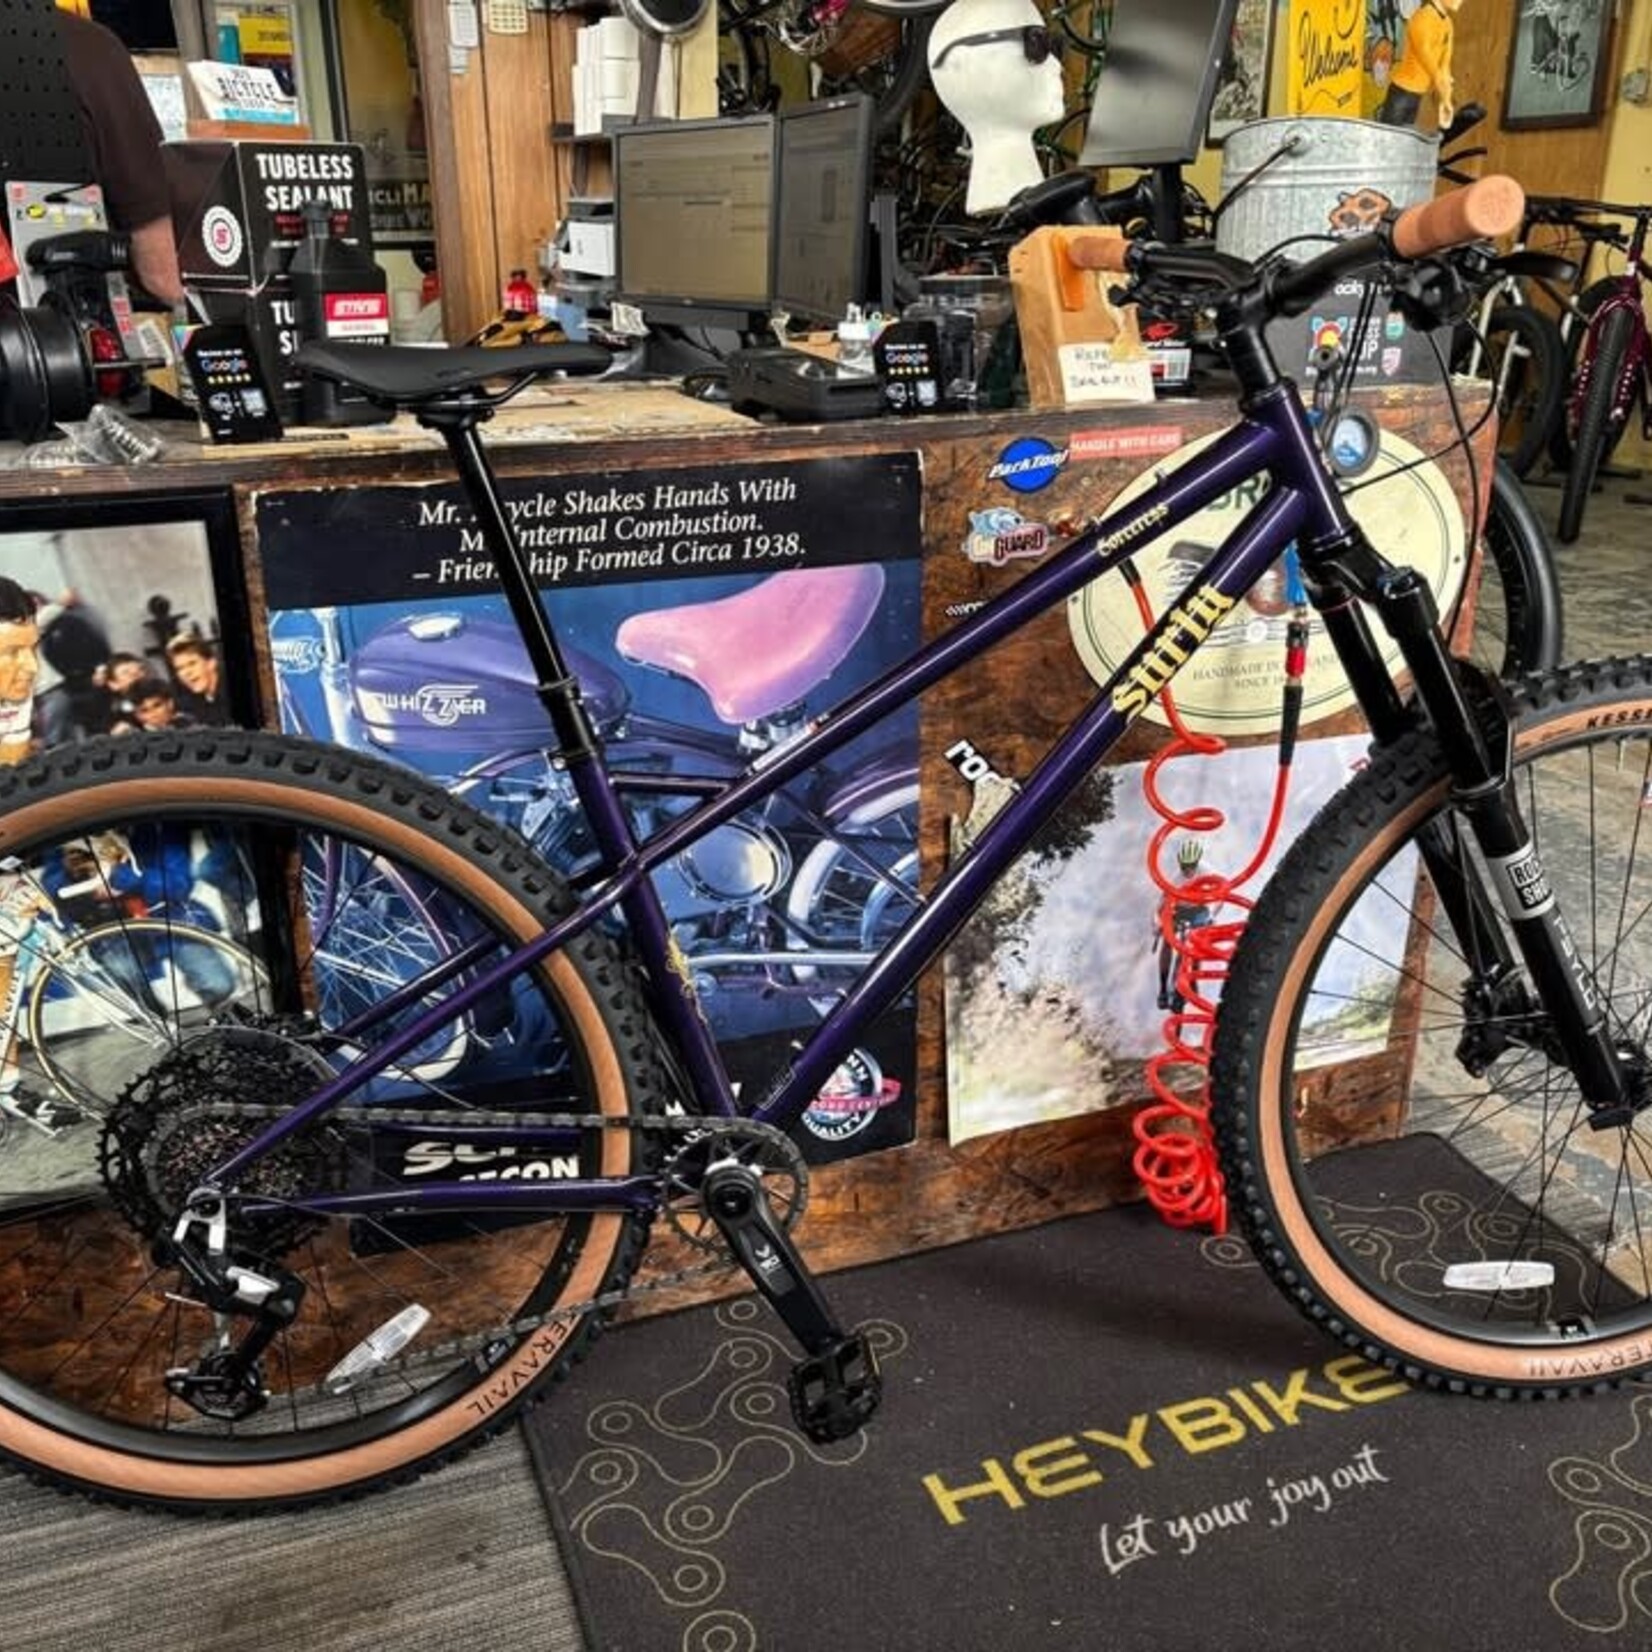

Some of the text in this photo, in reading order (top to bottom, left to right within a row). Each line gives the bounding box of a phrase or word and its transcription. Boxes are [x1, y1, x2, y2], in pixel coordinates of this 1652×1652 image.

[1299, 10, 1358, 88] Welcome
[256, 153, 353, 179] TUBELESS
[201, 358, 248, 373] Google
[419, 501, 462, 526] Mr.
[563, 486, 648, 515] Shakes
[653, 482, 729, 510] Hands
[739, 478, 797, 506] With
[512, 517, 606, 547] nternal
[615, 511, 763, 541] Combustion.
[575, 543, 664, 574] Formed
[671, 539, 732, 565] Circa
[742, 532, 806, 560] 1938.
[802, 1111, 861, 1137] QUALITY
[922, 1355, 1410, 1525] HEYBIKE
[1099, 1443, 1391, 1575] Let your joy out
